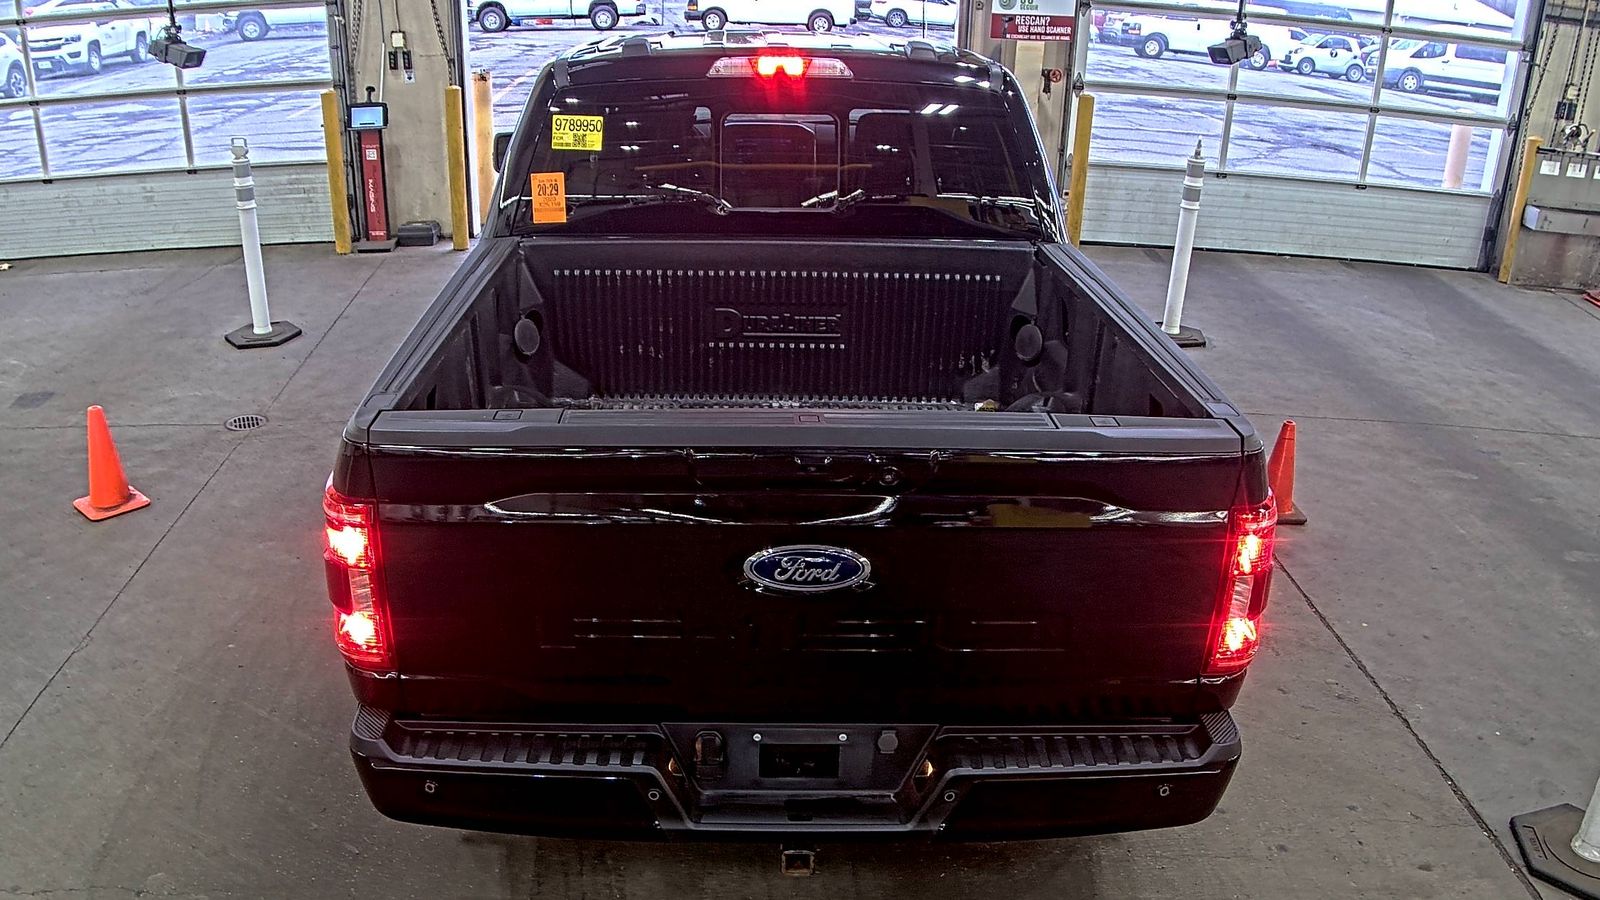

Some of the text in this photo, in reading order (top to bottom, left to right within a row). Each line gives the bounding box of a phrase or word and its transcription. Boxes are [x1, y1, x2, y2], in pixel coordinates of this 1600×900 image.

[1015, 15, 1051, 26] RESCAN?
[1018, 25, 1072, 34] USE HAND SCANNER
[555, 118, 602, 132] 9789950
[537, 183, 559, 197] 20:29
[774, 555, 843, 581] Ford
